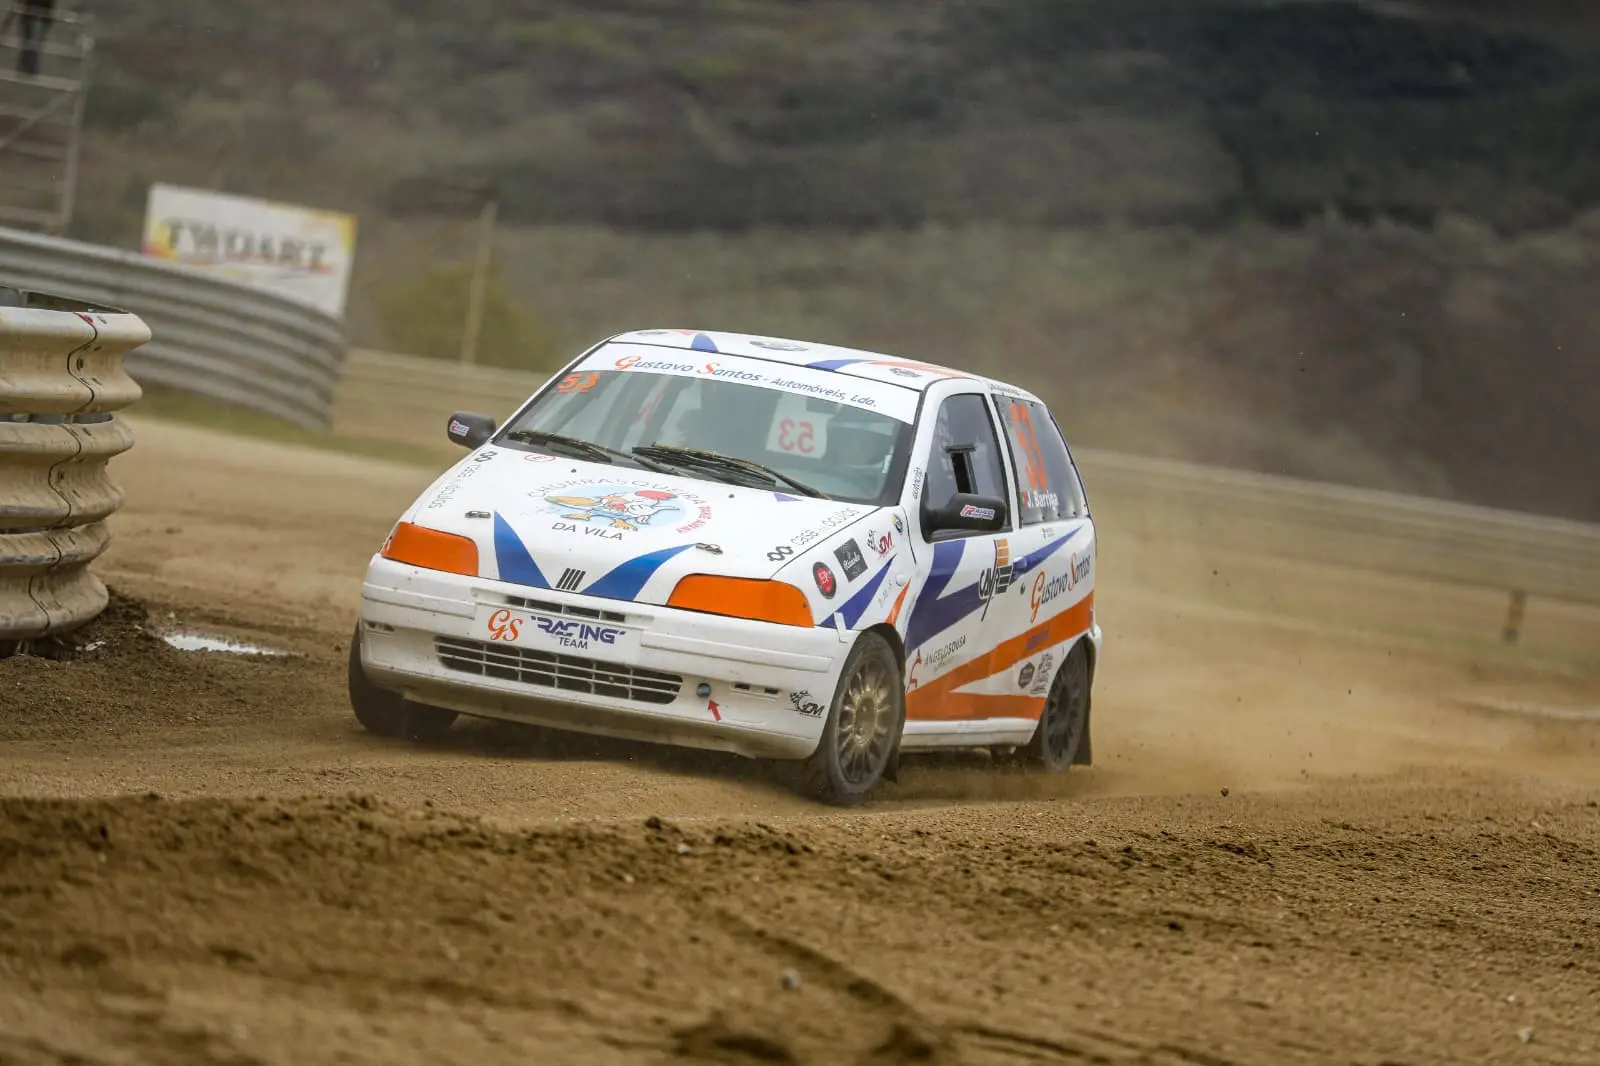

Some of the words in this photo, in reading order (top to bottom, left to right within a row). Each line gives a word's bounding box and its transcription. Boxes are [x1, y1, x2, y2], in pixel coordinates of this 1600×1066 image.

[614, 355, 693, 372] Gustavo
[696, 362, 762, 381] Santos
[771, 377, 846, 400] Automóveis,
[850, 394, 877, 408] Lda.
[1009, 402, 1047, 490] 53
[552, 522, 577, 533] DA
[585, 525, 623, 540] VILA
[1030, 571, 1068, 623] Gustavo
[1068, 552, 1091, 591] Santos
[488, 608, 523, 642] GS
[559, 636, 588, 649] TEAM
